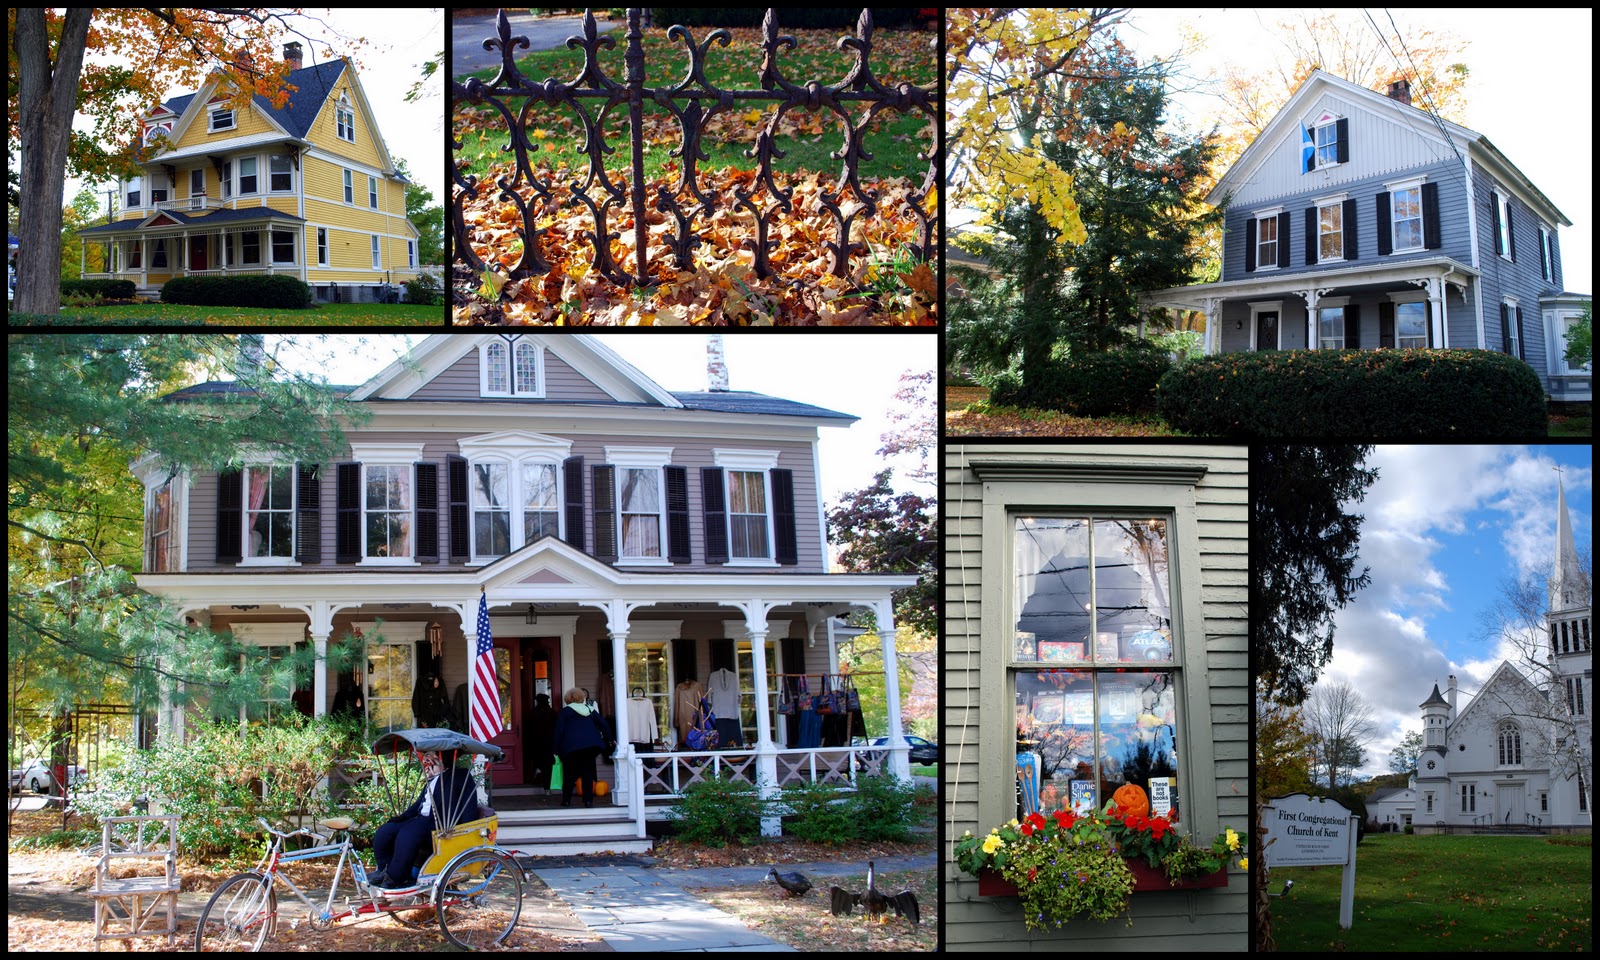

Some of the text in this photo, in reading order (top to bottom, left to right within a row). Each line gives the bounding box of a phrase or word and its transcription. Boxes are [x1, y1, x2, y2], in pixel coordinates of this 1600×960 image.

[1071, 782, 1095, 790] Danie
[1278, 809, 1347, 826] First Congregational
[1287, 825, 1339, 838] Church of Kent
